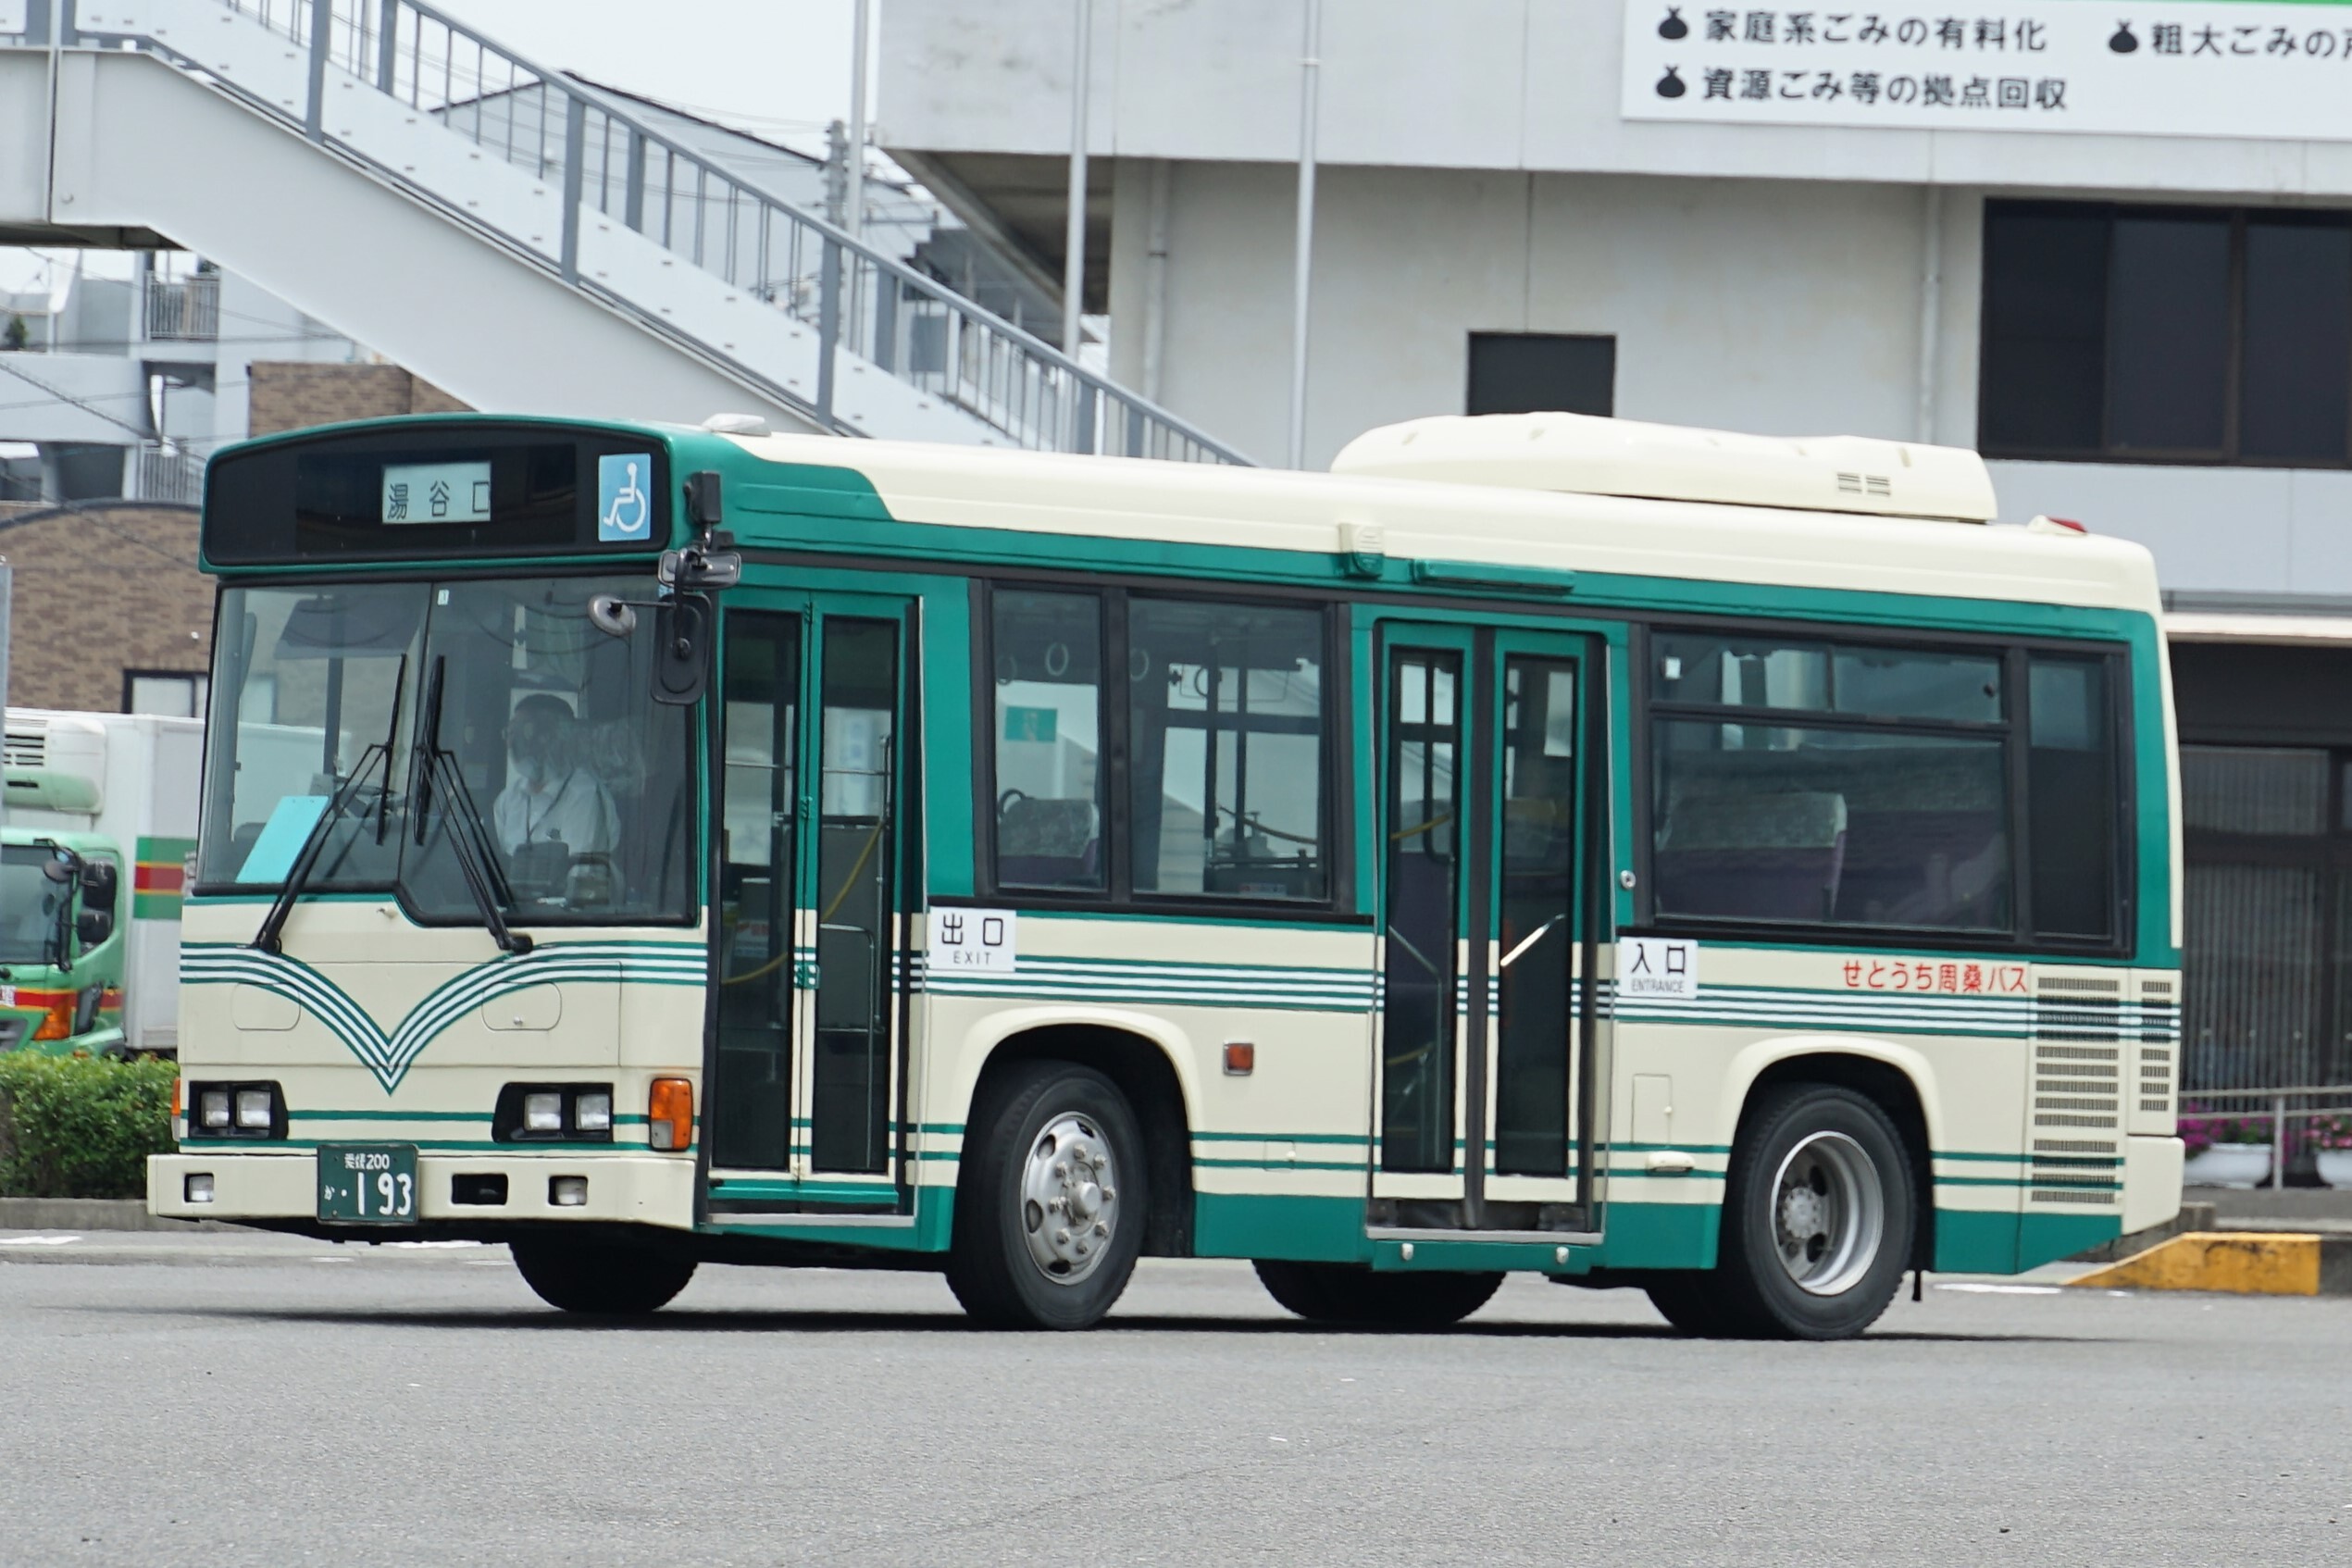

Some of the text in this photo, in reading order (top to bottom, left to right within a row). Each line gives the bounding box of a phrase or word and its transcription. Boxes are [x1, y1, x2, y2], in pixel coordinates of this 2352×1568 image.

[1705, 10, 2047, 52] 家庭系ごみの有料化
[1703, 68, 2067, 110] 資源ごみ等の拠点回収
[941, 913, 1004, 946] 出口
[953, 950, 991, 965] EXIT
[1631, 942, 1686, 976] 入口
[1631, 977, 1685, 993] ENTRANCE
[1842, 959, 2028, 993] せとうち周桑バス
